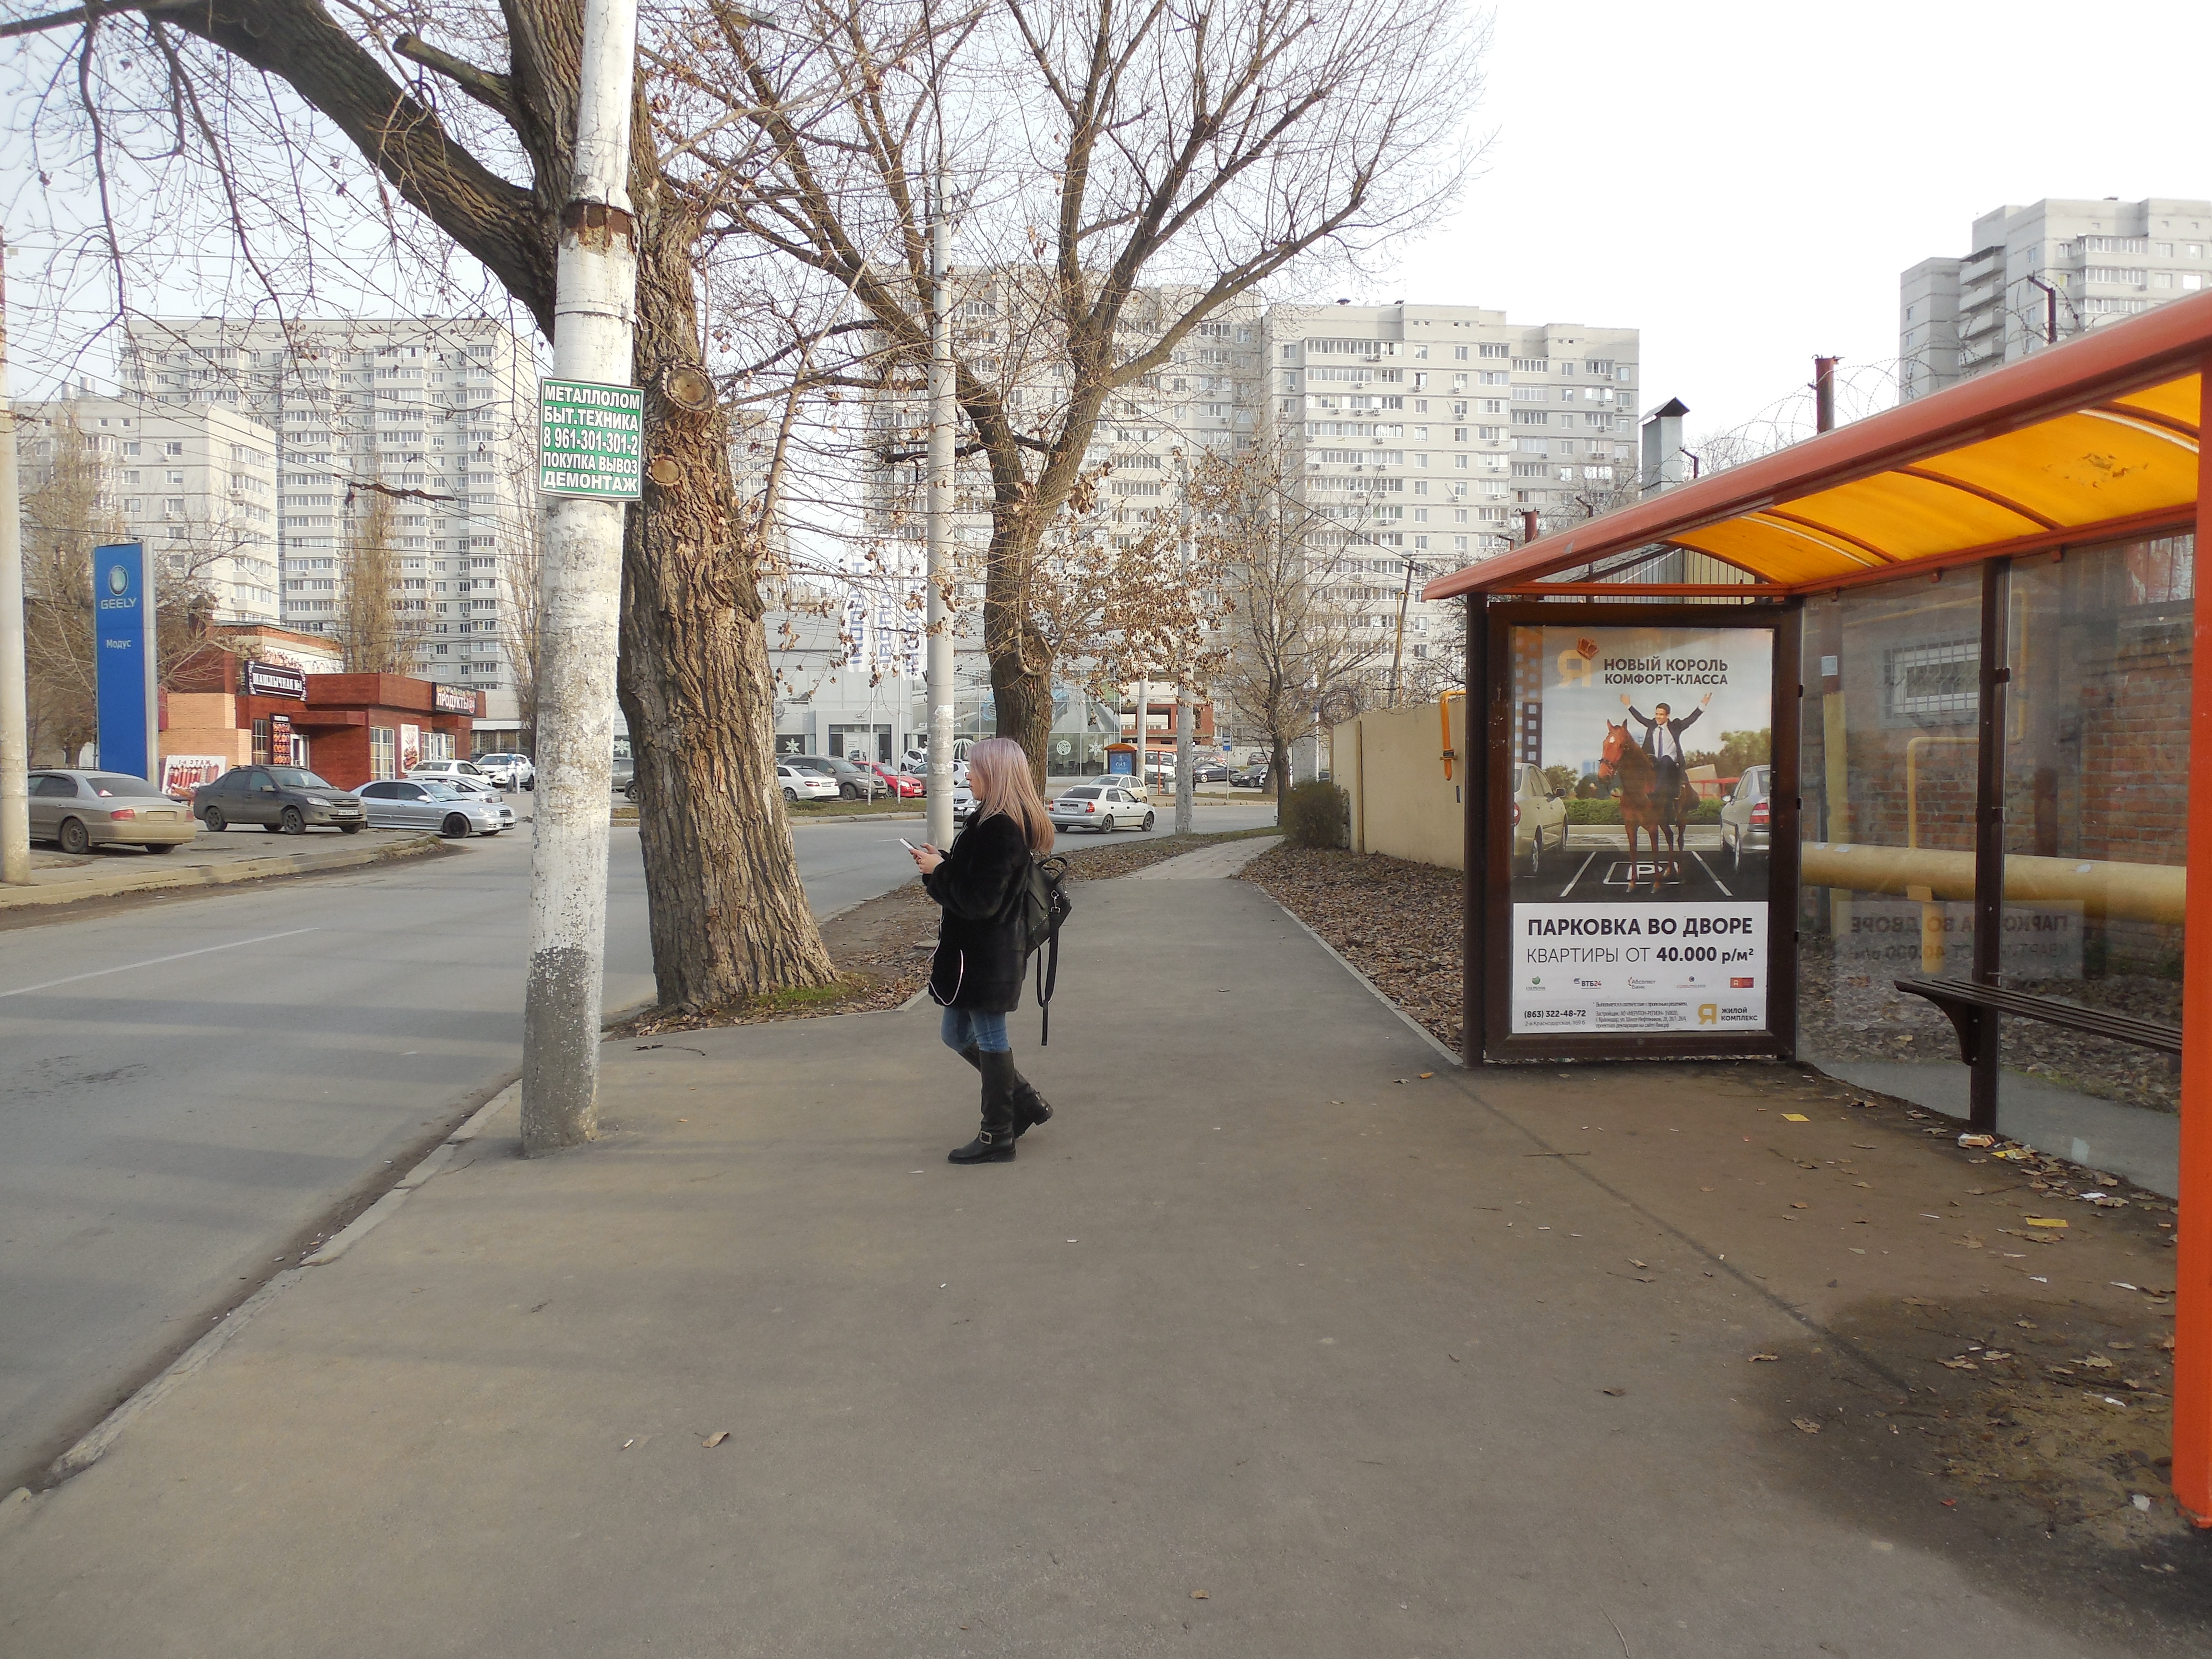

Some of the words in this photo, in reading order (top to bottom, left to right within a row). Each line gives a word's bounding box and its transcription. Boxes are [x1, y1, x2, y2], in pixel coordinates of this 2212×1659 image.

[544, 385, 640, 410] МЕТАЛЛОЛОМ
[543, 406, 638, 432] БЫТ.ТЕХНИКА
[543, 426, 551, 447] 8
[554, 427, 638, 456] 961-301-301-2
[543, 451, 596, 470] ПОКУПКА
[598, 456, 637, 475] ВЫВОЗ
[543, 470, 638, 492] ДЕМОНТАЖ
[101, 598, 137, 610] GEELY
[107, 639, 132, 649] Модус
[1604, 656, 1660, 671] НОВЫЙ
[1666, 659, 1729, 672] КОРОЛЬ
[252, 673, 293, 690] ШАШЛЫЧНАЯ
[1605, 673, 1728, 685] КОМФОРТ-КЛАССА
[436, 693, 469, 710] ПРОДУКТЫ
[1528, 918, 1642, 936] ПАРКОВКА
[1648, 918, 1677, 935] ВО
[1683, 917, 1753, 938] ДВОРЕ
[1527, 948, 1618, 963] КВАРТИРЫ
[1626, 948, 1650, 962] ОТ
[1656, 946, 1717, 962] 40.000
[1524, 1010, 1544, 1019] (863)
